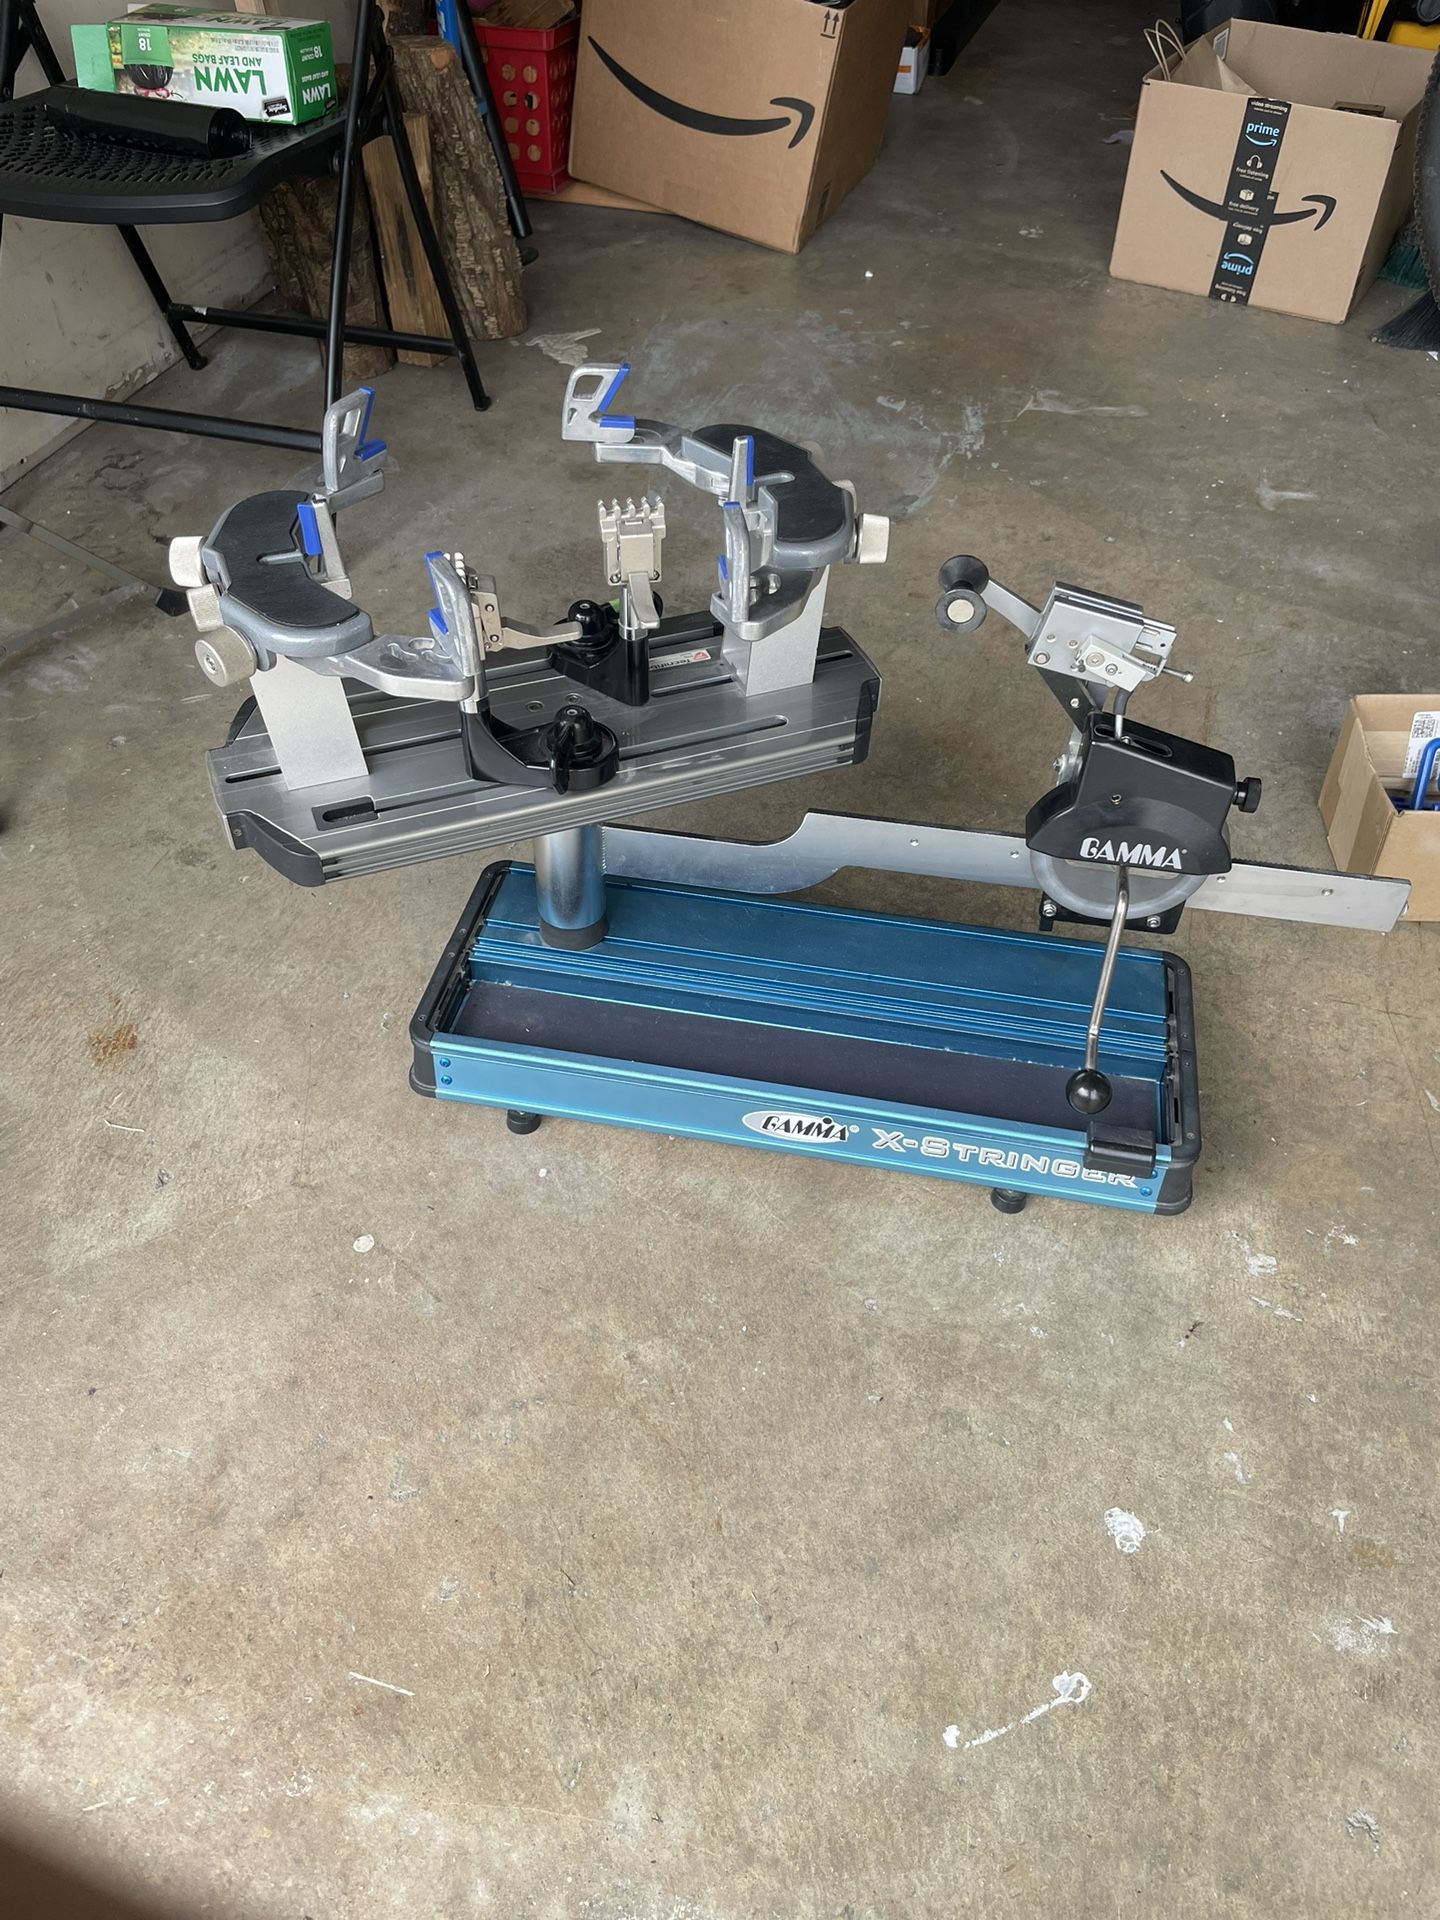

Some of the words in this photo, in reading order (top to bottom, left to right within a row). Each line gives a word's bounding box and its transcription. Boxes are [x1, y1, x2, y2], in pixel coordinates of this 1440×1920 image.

[138, 38, 152, 51] 18
[192, 53, 217, 64] BAGS
[313, 45, 323, 59] 18
[218, 55, 240, 66] LEAF
[241, 56, 262, 67] AND
[193, 66, 267, 95] LAWN
[302, 82, 331, 105] LAWN
[1265, 102, 1288, 113] streaming
[1245, 122, 1280, 137] prime
[1235, 166, 1247, 174] free
[1246, 168, 1269, 180] listening
[1228, 200, 1240, 208] free
[1239, 202, 1260, 213] delivery
[1220, 260, 1254, 276] prime
[1079, 837, 1183, 870] GAMMA
[761, 1114, 848, 1143] GAMMA
[871, 1127, 1139, 1190] X-STRINGER
